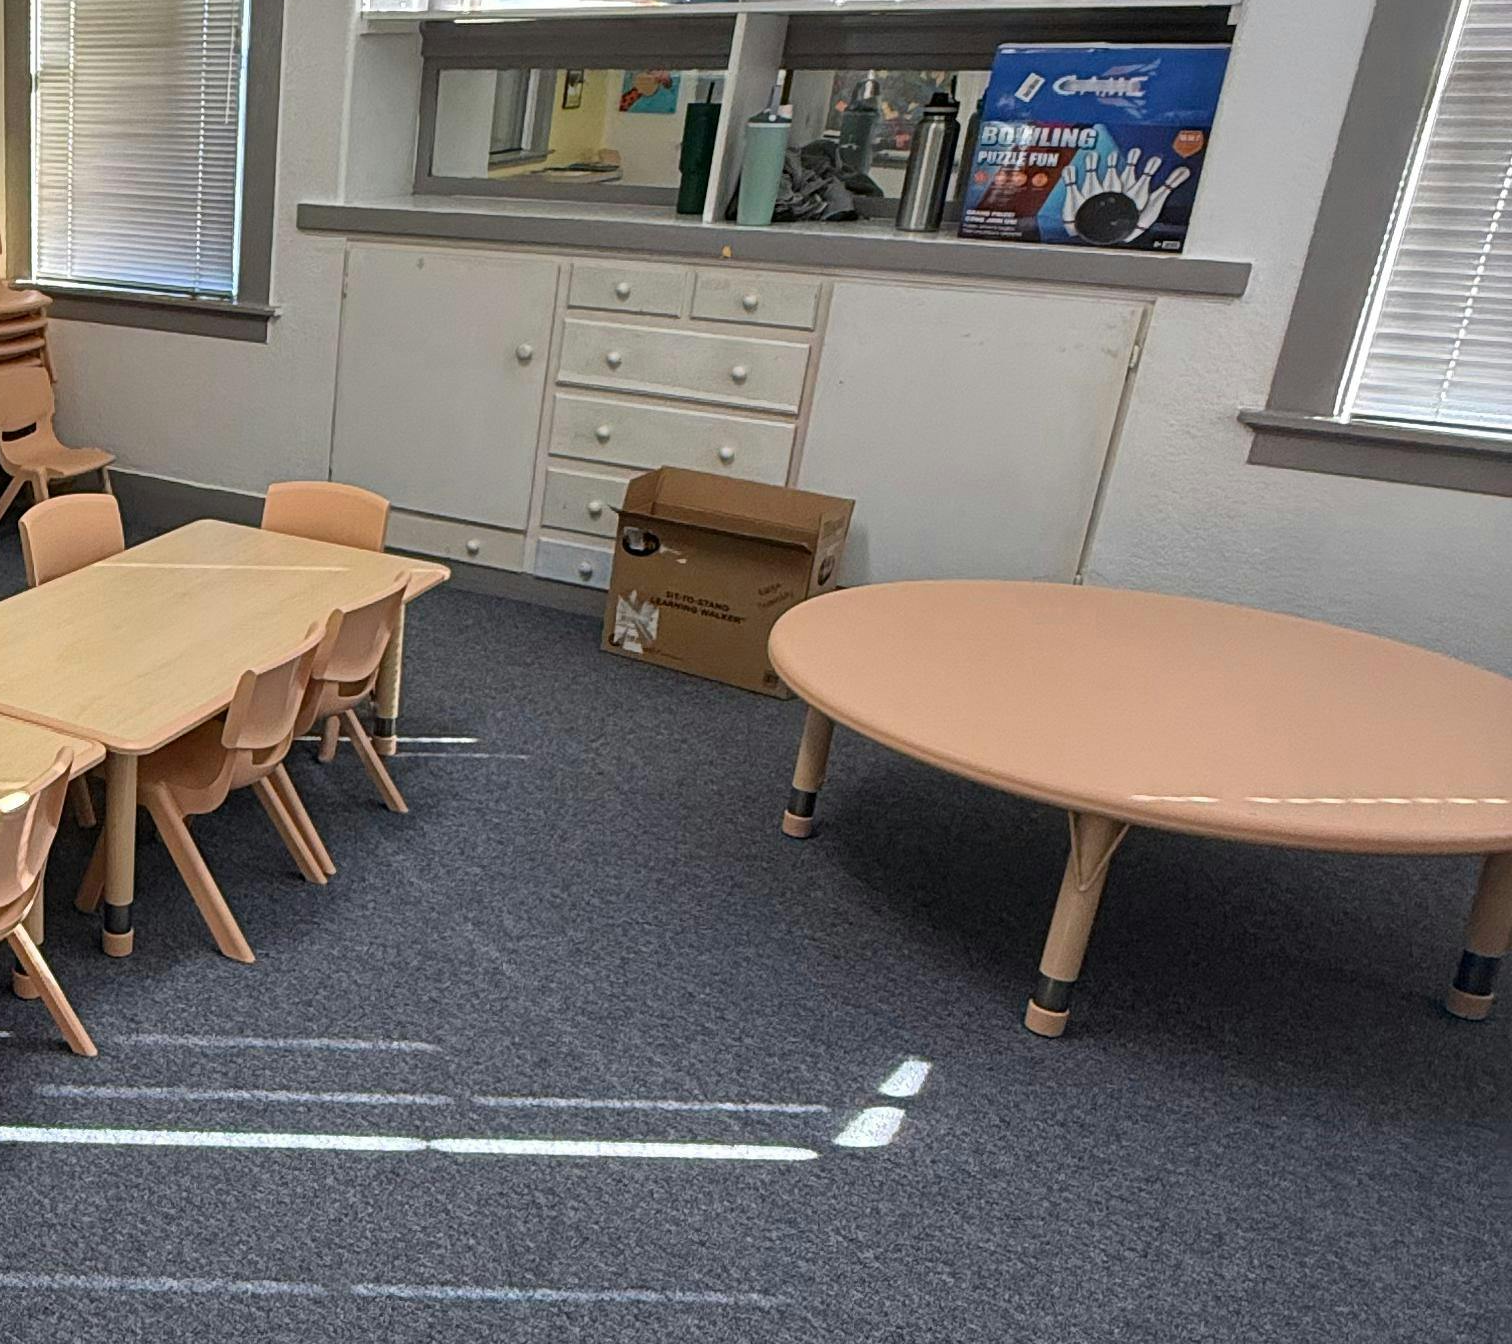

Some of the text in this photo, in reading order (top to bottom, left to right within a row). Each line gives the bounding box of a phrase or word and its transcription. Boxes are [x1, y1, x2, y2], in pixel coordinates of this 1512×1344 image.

[981, 125, 1097, 149] BOWLING
[977, 150, 1059, 167] PUZZLE FUN
[650, 596, 698, 614] LEARNING
[666, 590, 730, 612] SIT-TO-STAND
